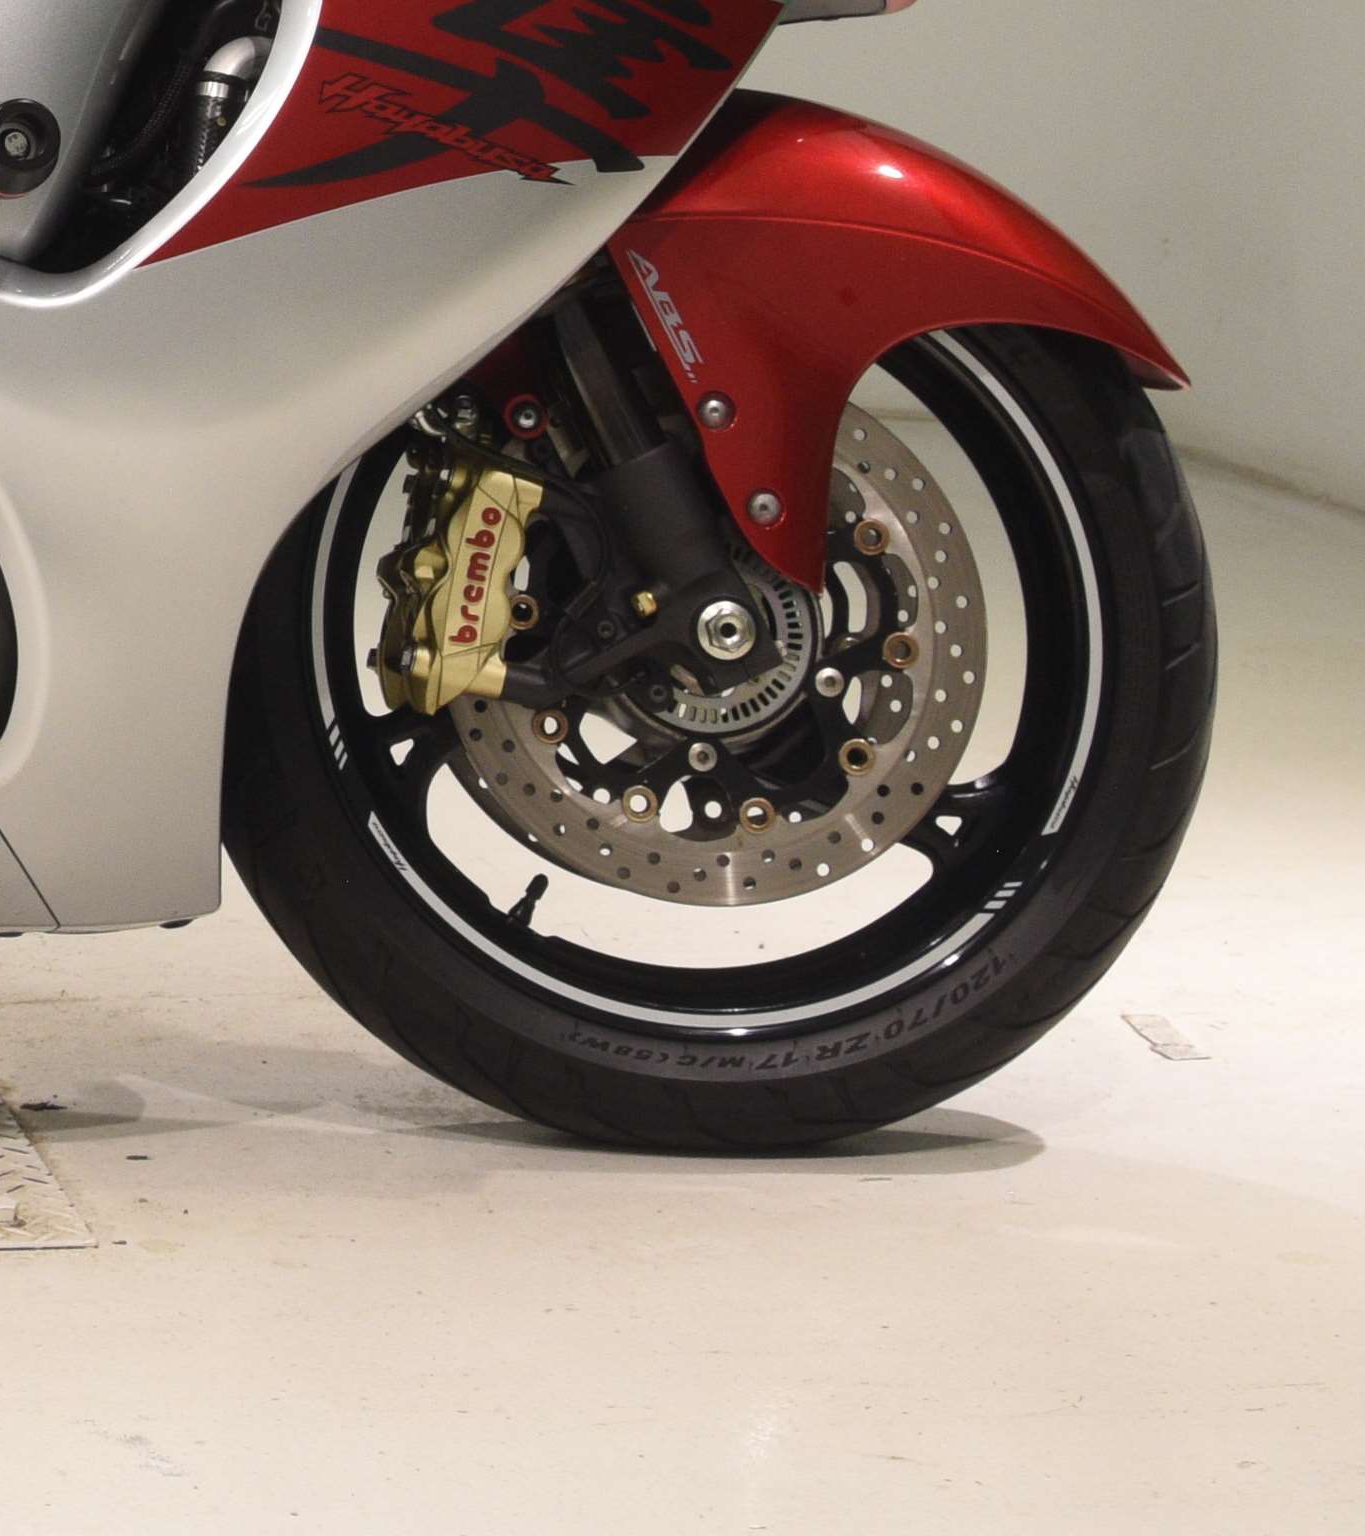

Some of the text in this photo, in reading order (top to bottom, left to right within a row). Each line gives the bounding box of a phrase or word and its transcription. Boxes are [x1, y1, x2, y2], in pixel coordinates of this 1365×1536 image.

[318, 72, 575, 185] Hayabusa
[626, 249, 704, 365] ABS
[448, 505, 503, 646] brembo
